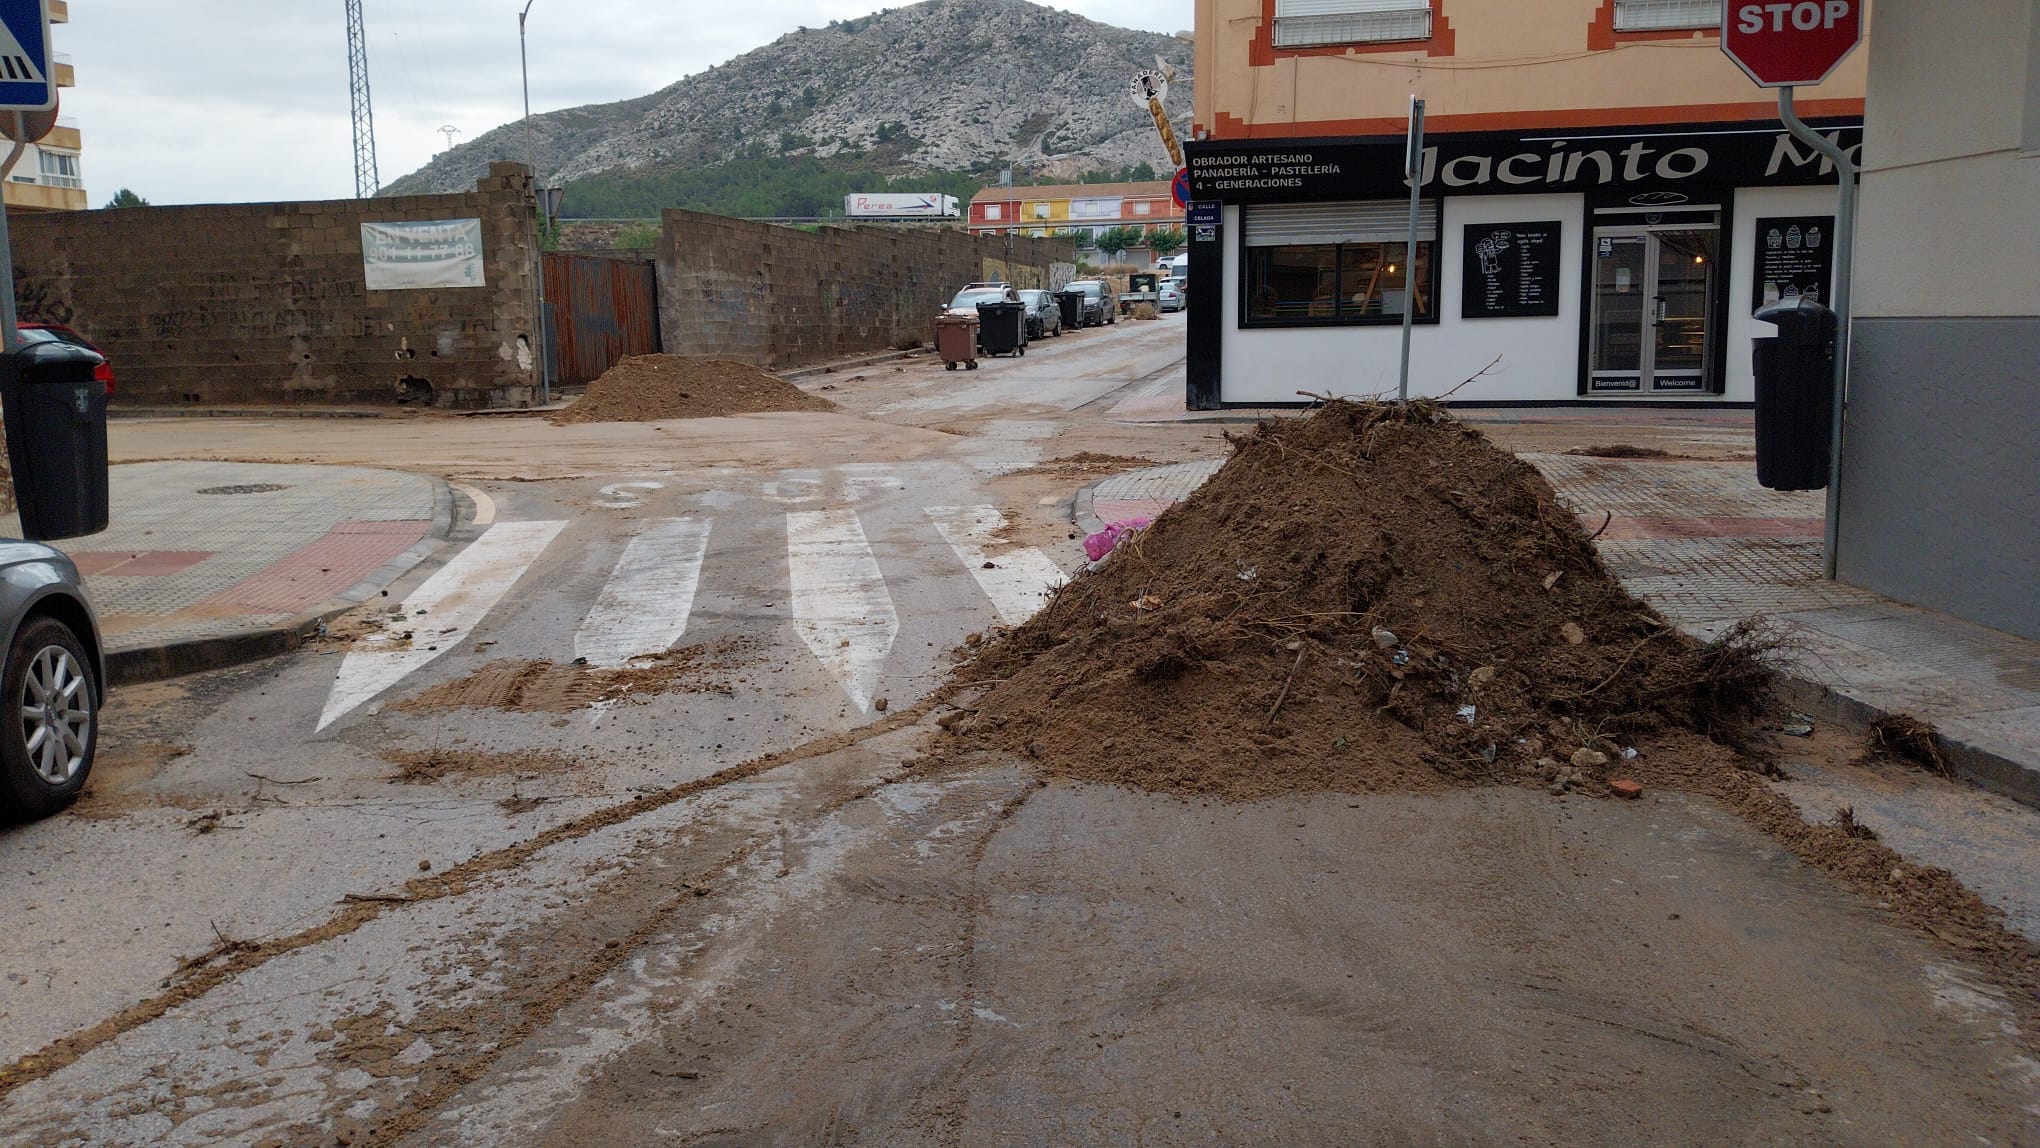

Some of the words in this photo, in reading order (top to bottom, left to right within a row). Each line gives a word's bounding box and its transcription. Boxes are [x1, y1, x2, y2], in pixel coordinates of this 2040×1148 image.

[1738, 1, 1849, 34] STOP
[1192, 155, 1248, 167] OBRADOR
[1251, 153, 1313, 164] ARTESANO
[1403, 140, 1709, 187] Jacinto
[1193, 166, 1259, 178] PANADERÍA
[1271, 163, 1341, 175] PASTELERÍA
[1196, 181, 1203, 190] 4
[1215, 177, 1303, 189] GENERACIONES
[857, 197, 893, 210] Perea
[375, 227, 400, 244] EN
[405, 223, 469, 242] VENTA
[369, 246, 396, 260] 901
[406, 245, 421, 259] 11
[430, 244, 449, 259] 77
[455, 243, 474, 258] 88
[1595, 380, 1637, 388] Bienvenid@
[1660, 379, 1696, 387] Welcome
